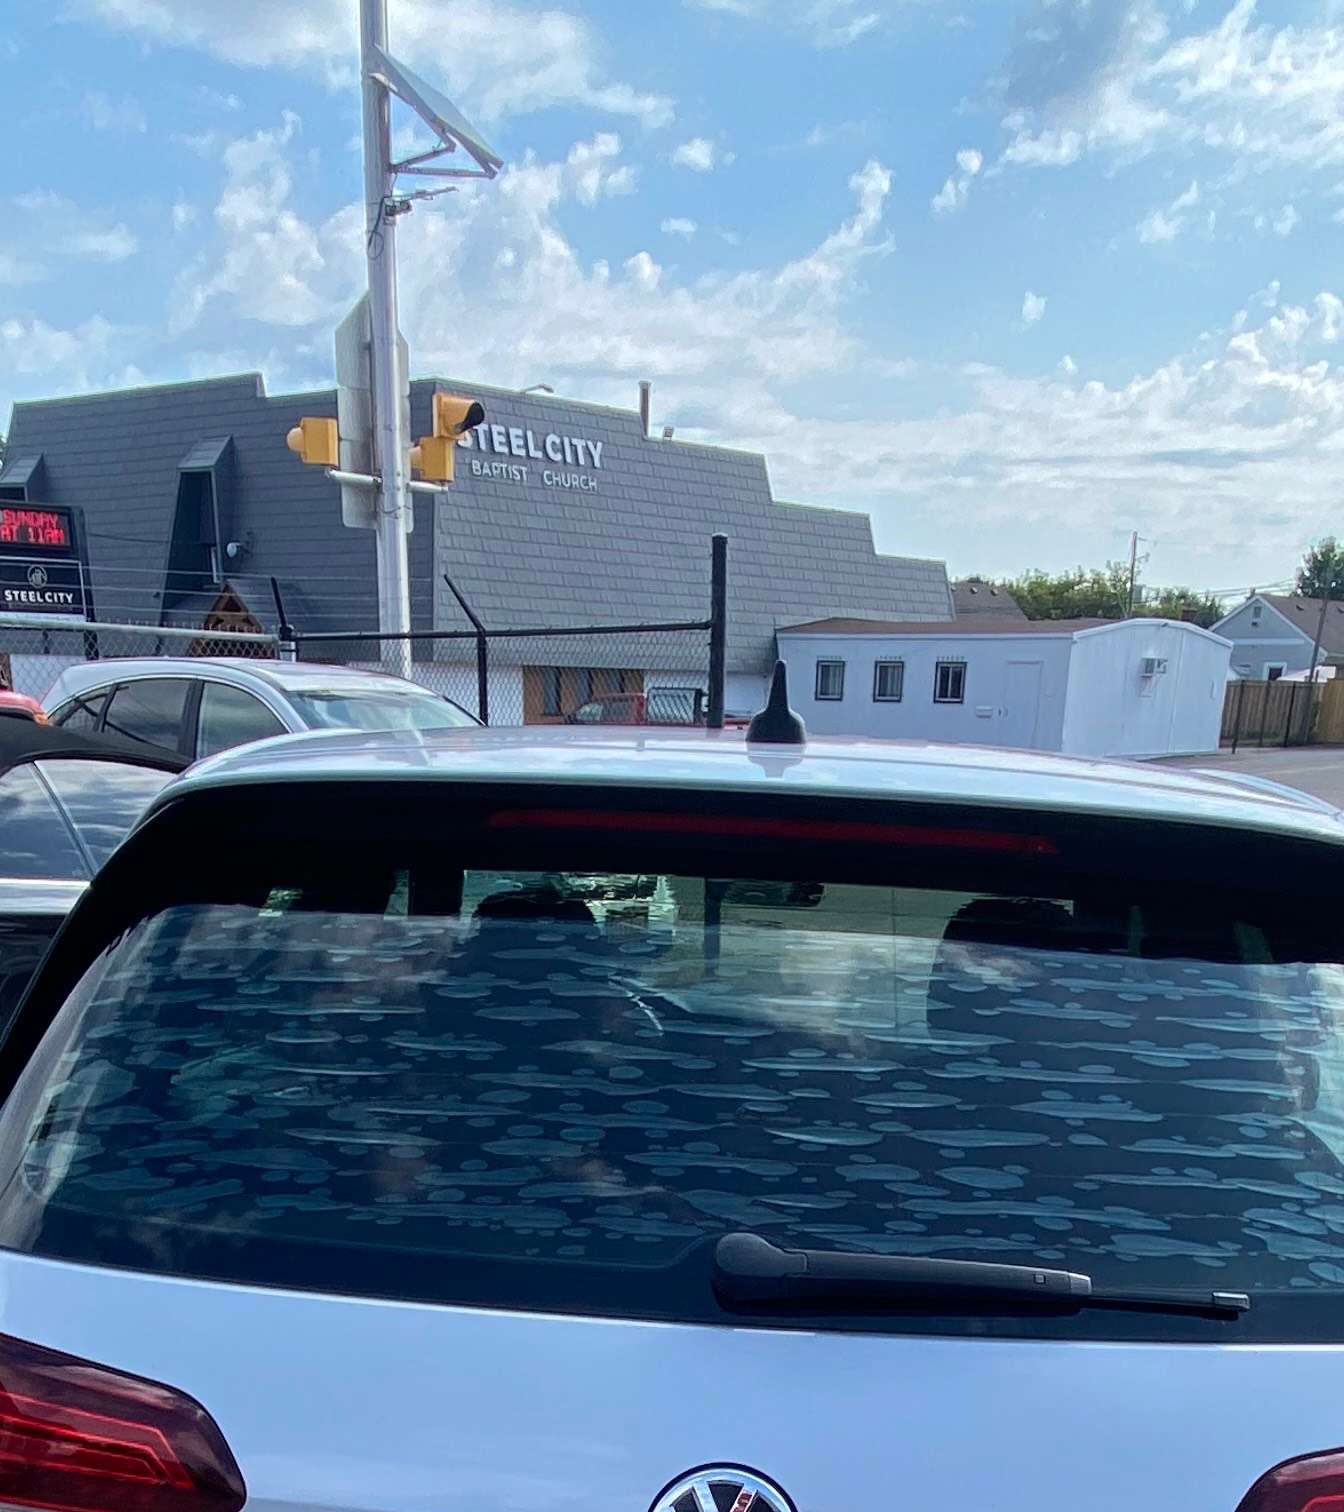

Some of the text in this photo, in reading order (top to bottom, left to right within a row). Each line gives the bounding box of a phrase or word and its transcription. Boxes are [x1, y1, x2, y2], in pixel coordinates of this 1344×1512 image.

[471, 459, 598, 492] BAPTIST CHURCH
[0, 524, 18, 541] AT
